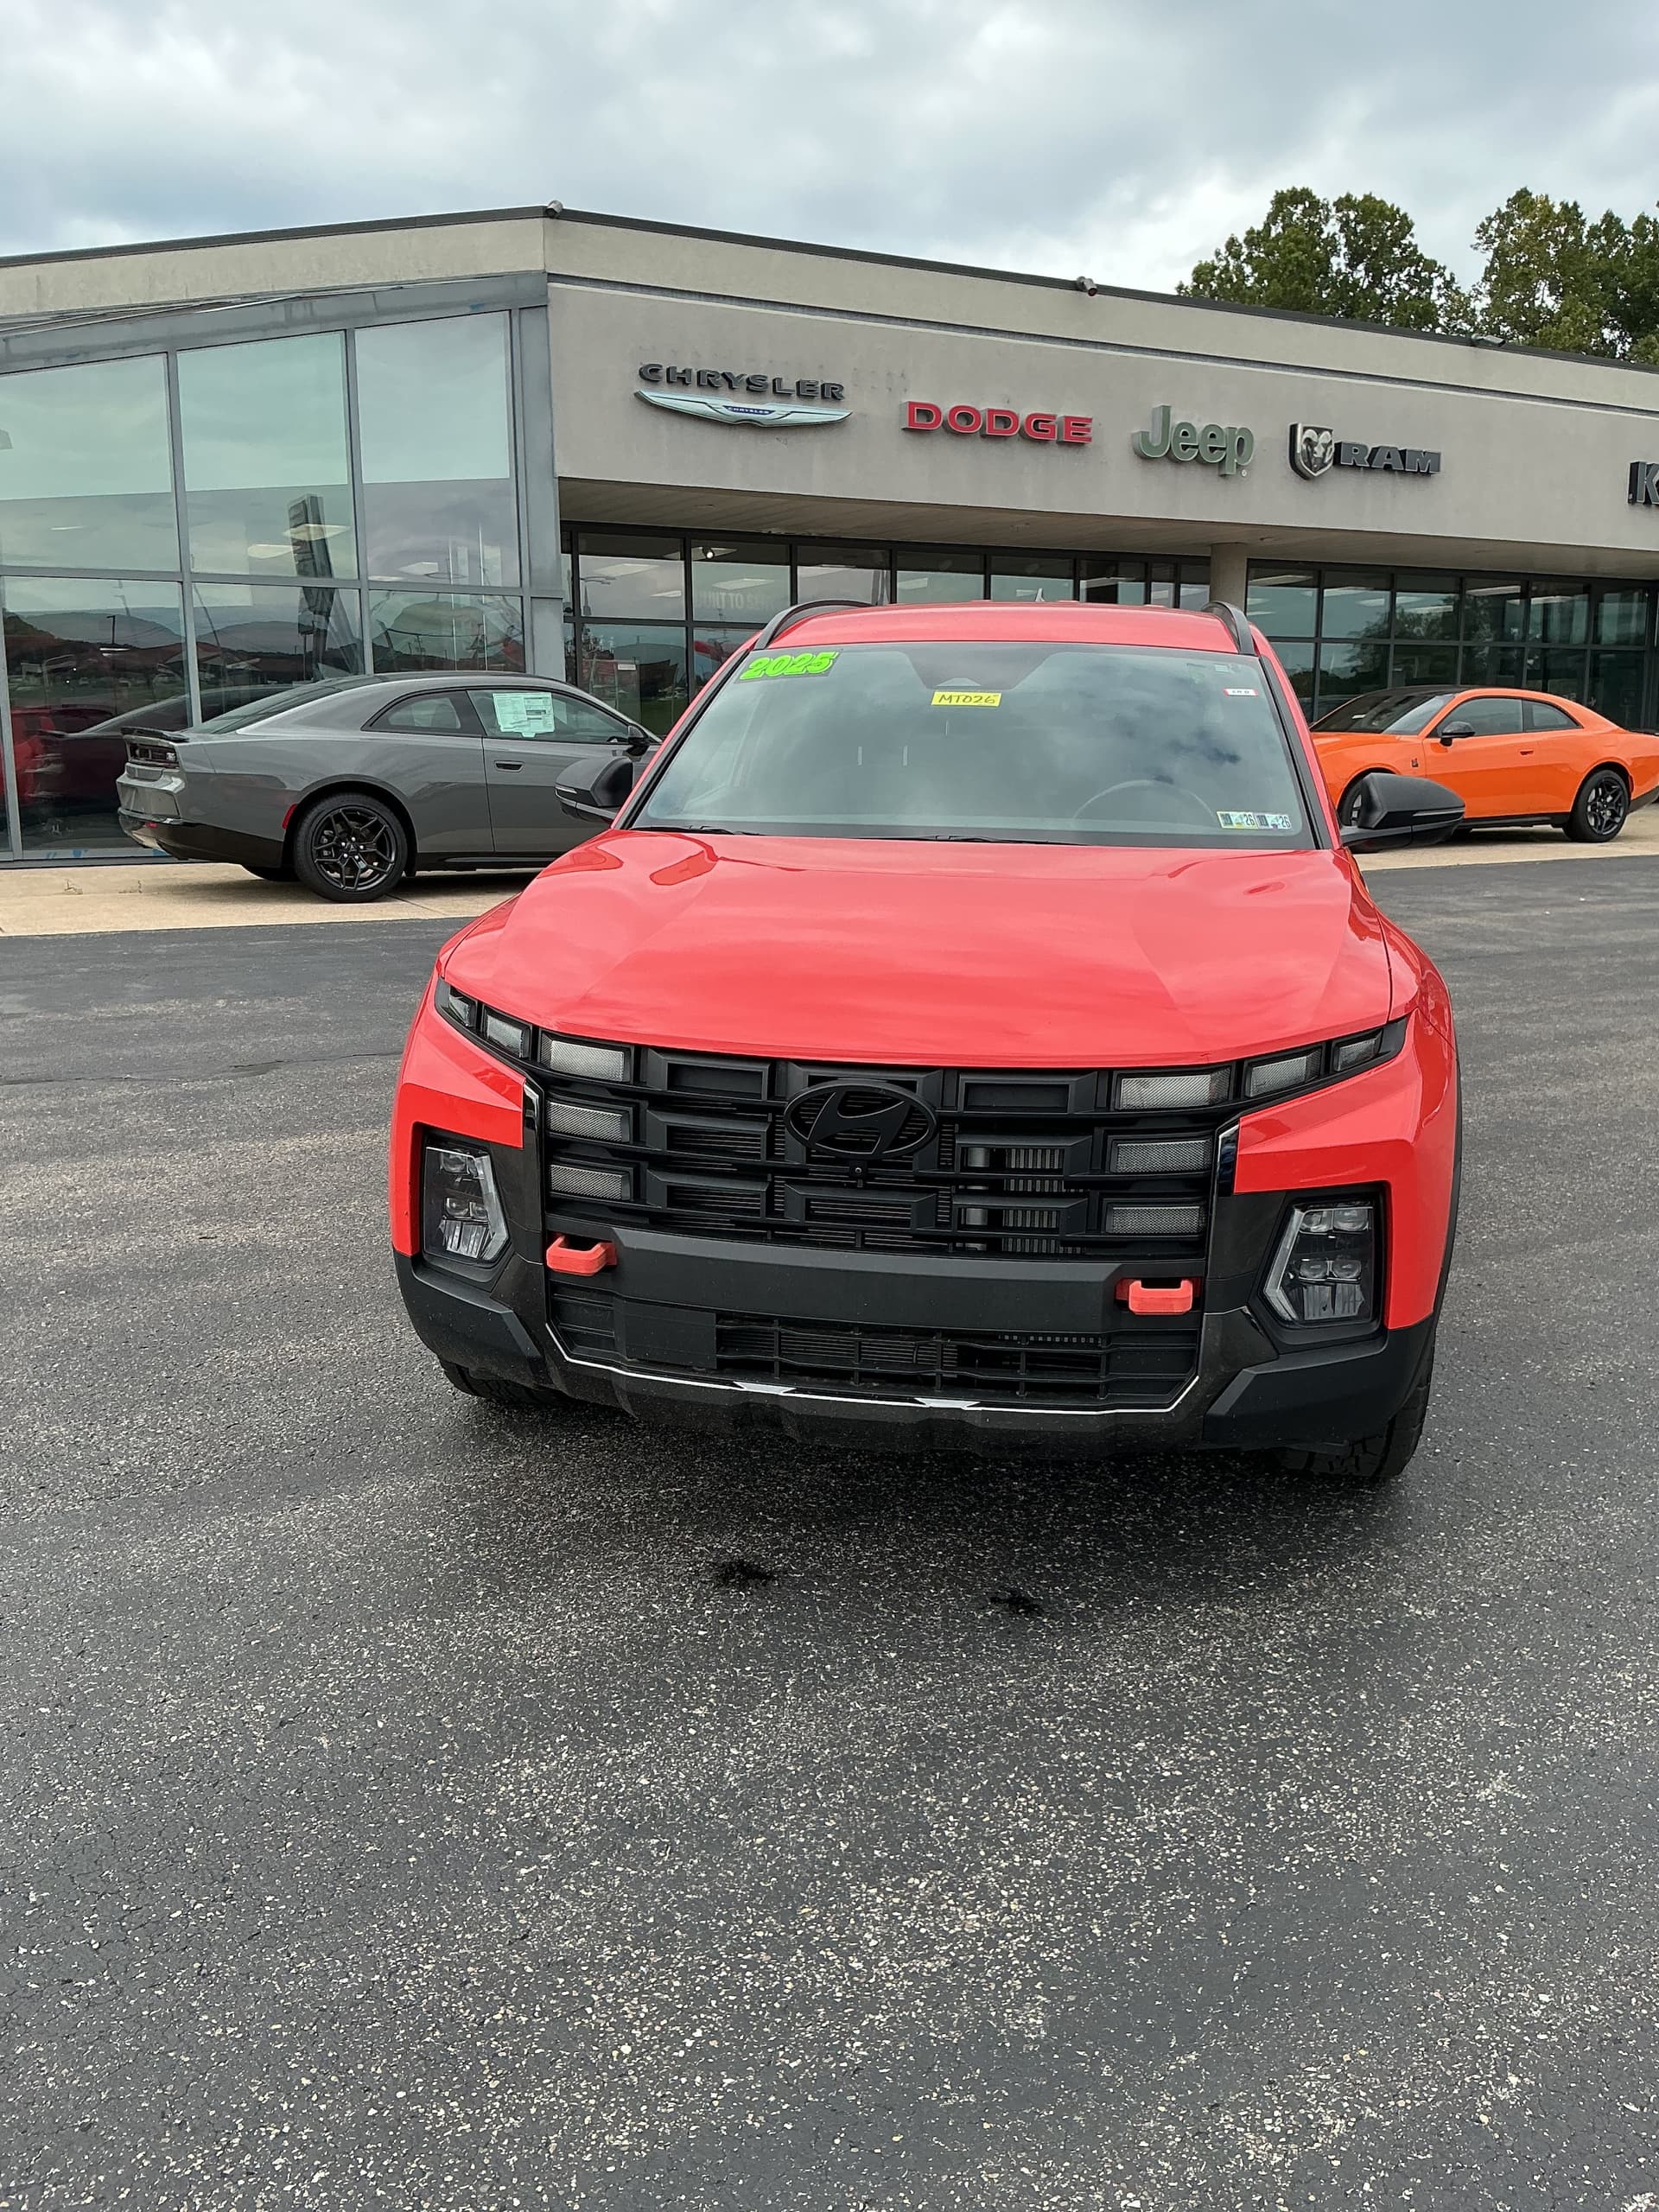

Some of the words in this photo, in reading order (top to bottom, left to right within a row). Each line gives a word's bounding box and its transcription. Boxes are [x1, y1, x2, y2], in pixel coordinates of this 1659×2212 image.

[639, 363, 845, 401] CHRYSLER
[903, 401, 1093, 443] DODGE
[1134, 404, 1255, 476] Jeep
[1336, 442, 1441, 474] RAM
[740, 651, 840, 680] 2025
[1244, 813, 1255, 826] 26
